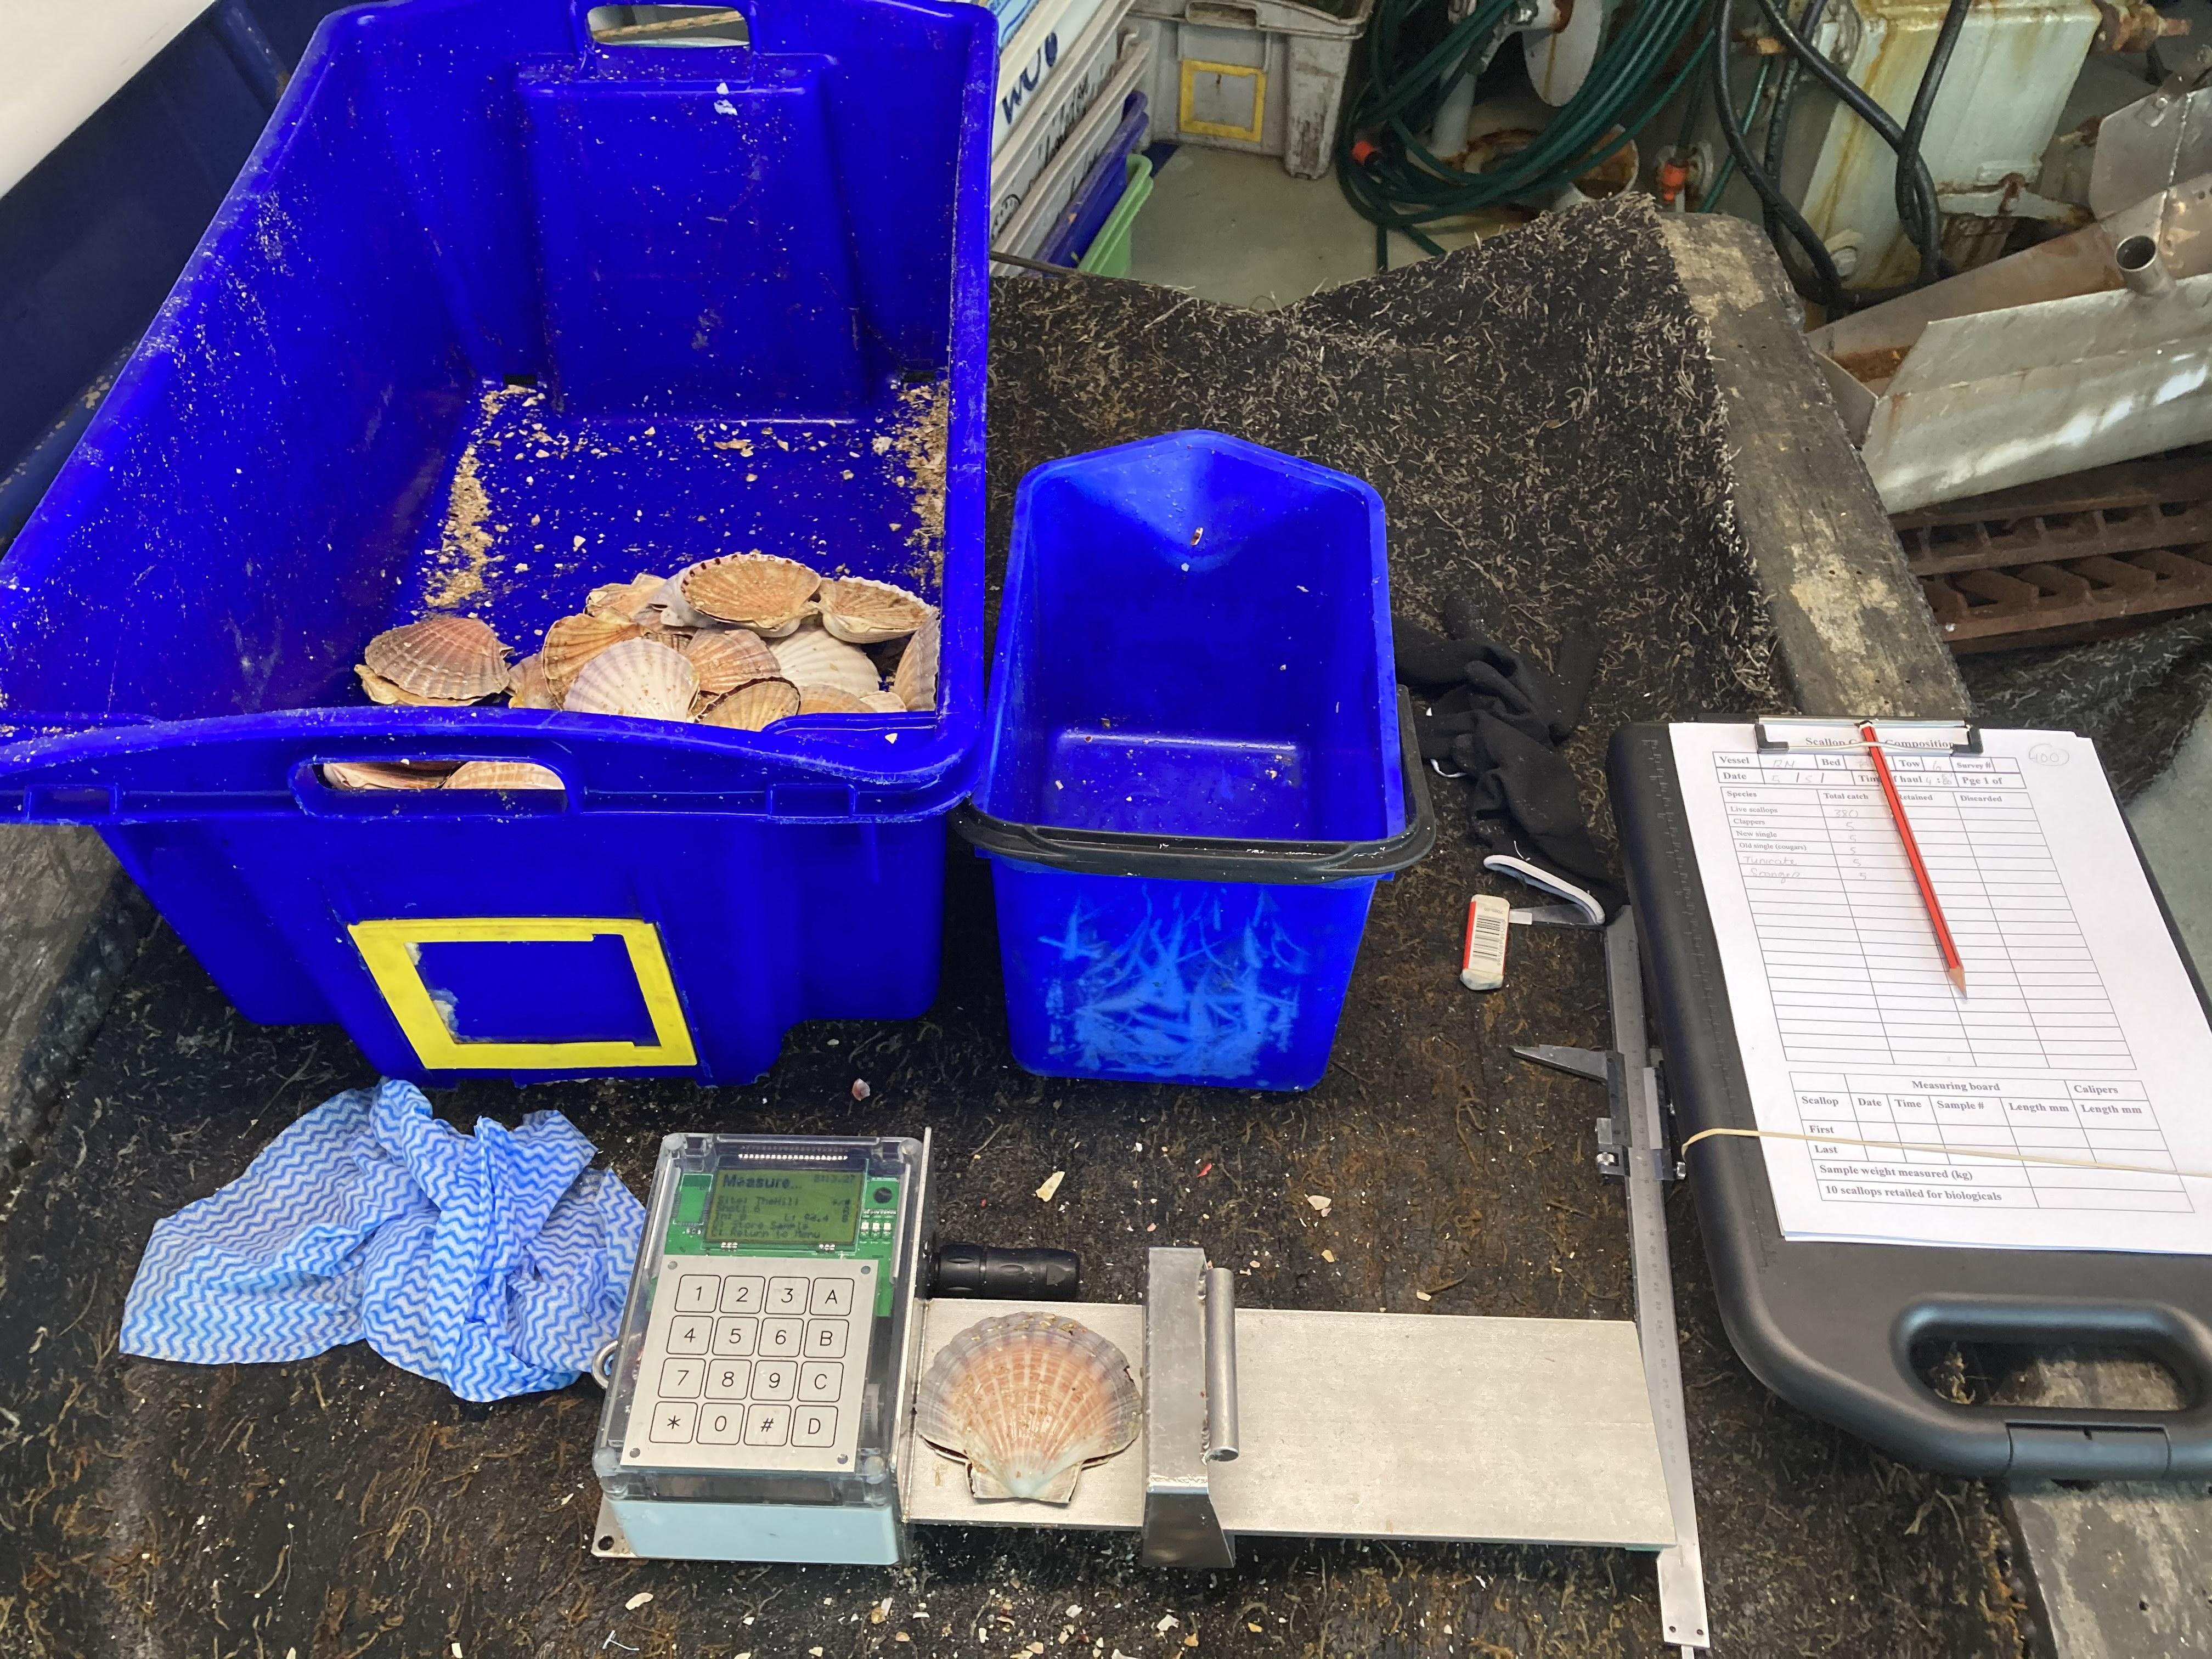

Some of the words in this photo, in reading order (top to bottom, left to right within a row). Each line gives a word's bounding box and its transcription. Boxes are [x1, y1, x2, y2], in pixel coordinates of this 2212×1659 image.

[1719, 756, 1750, 764] Vessel
[1821, 758, 1841, 766] Bed
[1723, 771, 1747, 780] Date
[1858, 774, 1881, 783] Tim
[1900, 775, 1922, 783] haul
[1962, 777, 1982, 786] Pge
[1992, 776, 2003, 785] of
[1960, 794, 2002, 803] Discarded
[1775, 843, 1807, 851] (cougars)
[1912, 1080, 1965, 1093] Measuring
[1968, 1081, 2001, 1092] board
[2074, 1084, 2119, 1096] Calipers
[1801, 1095, 1839, 1108] Scallop
[1858, 1097, 1882, 1108] Date
[1894, 1098, 1922, 1109] Time
[1937, 1099, 1976, 1111] Sample
[1978, 1101, 1985, 1110] #
[2008, 1102, 2047, 1115] Length
[2050, 1104, 2070, 1113] mm
[2080, 1103, 2119, 1116] Length
[2122, 1106, 2143, 1115] mm
[1809, 1124, 1835, 1135] First
[1814, 1144, 1839, 1155] Last
[1819, 1164, 1859, 1177] Sample
[1861, 1166, 1897, 1180] weight
[1898, 1167, 1949, 1179] measured
[1951, 1169, 1973, 1181] (kg)
[1825, 1184, 1838, 1194] 10
[1840, 1185, 1883, 1198] scallops
[1884, 1187, 1923, 1198] retailed
[1926, 1188, 1943, 1199] for
[1945, 1189, 2002, 1203] biologicals
[696, 1286, 702, 1301] 1
[736, 1287, 748, 1302] 2
[781, 1288, 793, 1303] 3
[825, 1289, 838, 1304] A
[684, 1328, 696, 1343] 4
[729, 1329, 741, 1344] 5
[775, 1330, 787, 1345] 6
[820, 1330, 833, 1346] B
[677, 1370, 689, 1386] 7
[722, 1372, 734, 1387] 8
[769, 1373, 780, 1388] 9
[814, 1374, 827, 1389] C
[760, 1418, 774, 1432] #
[808, 1418, 821, 1434] D
